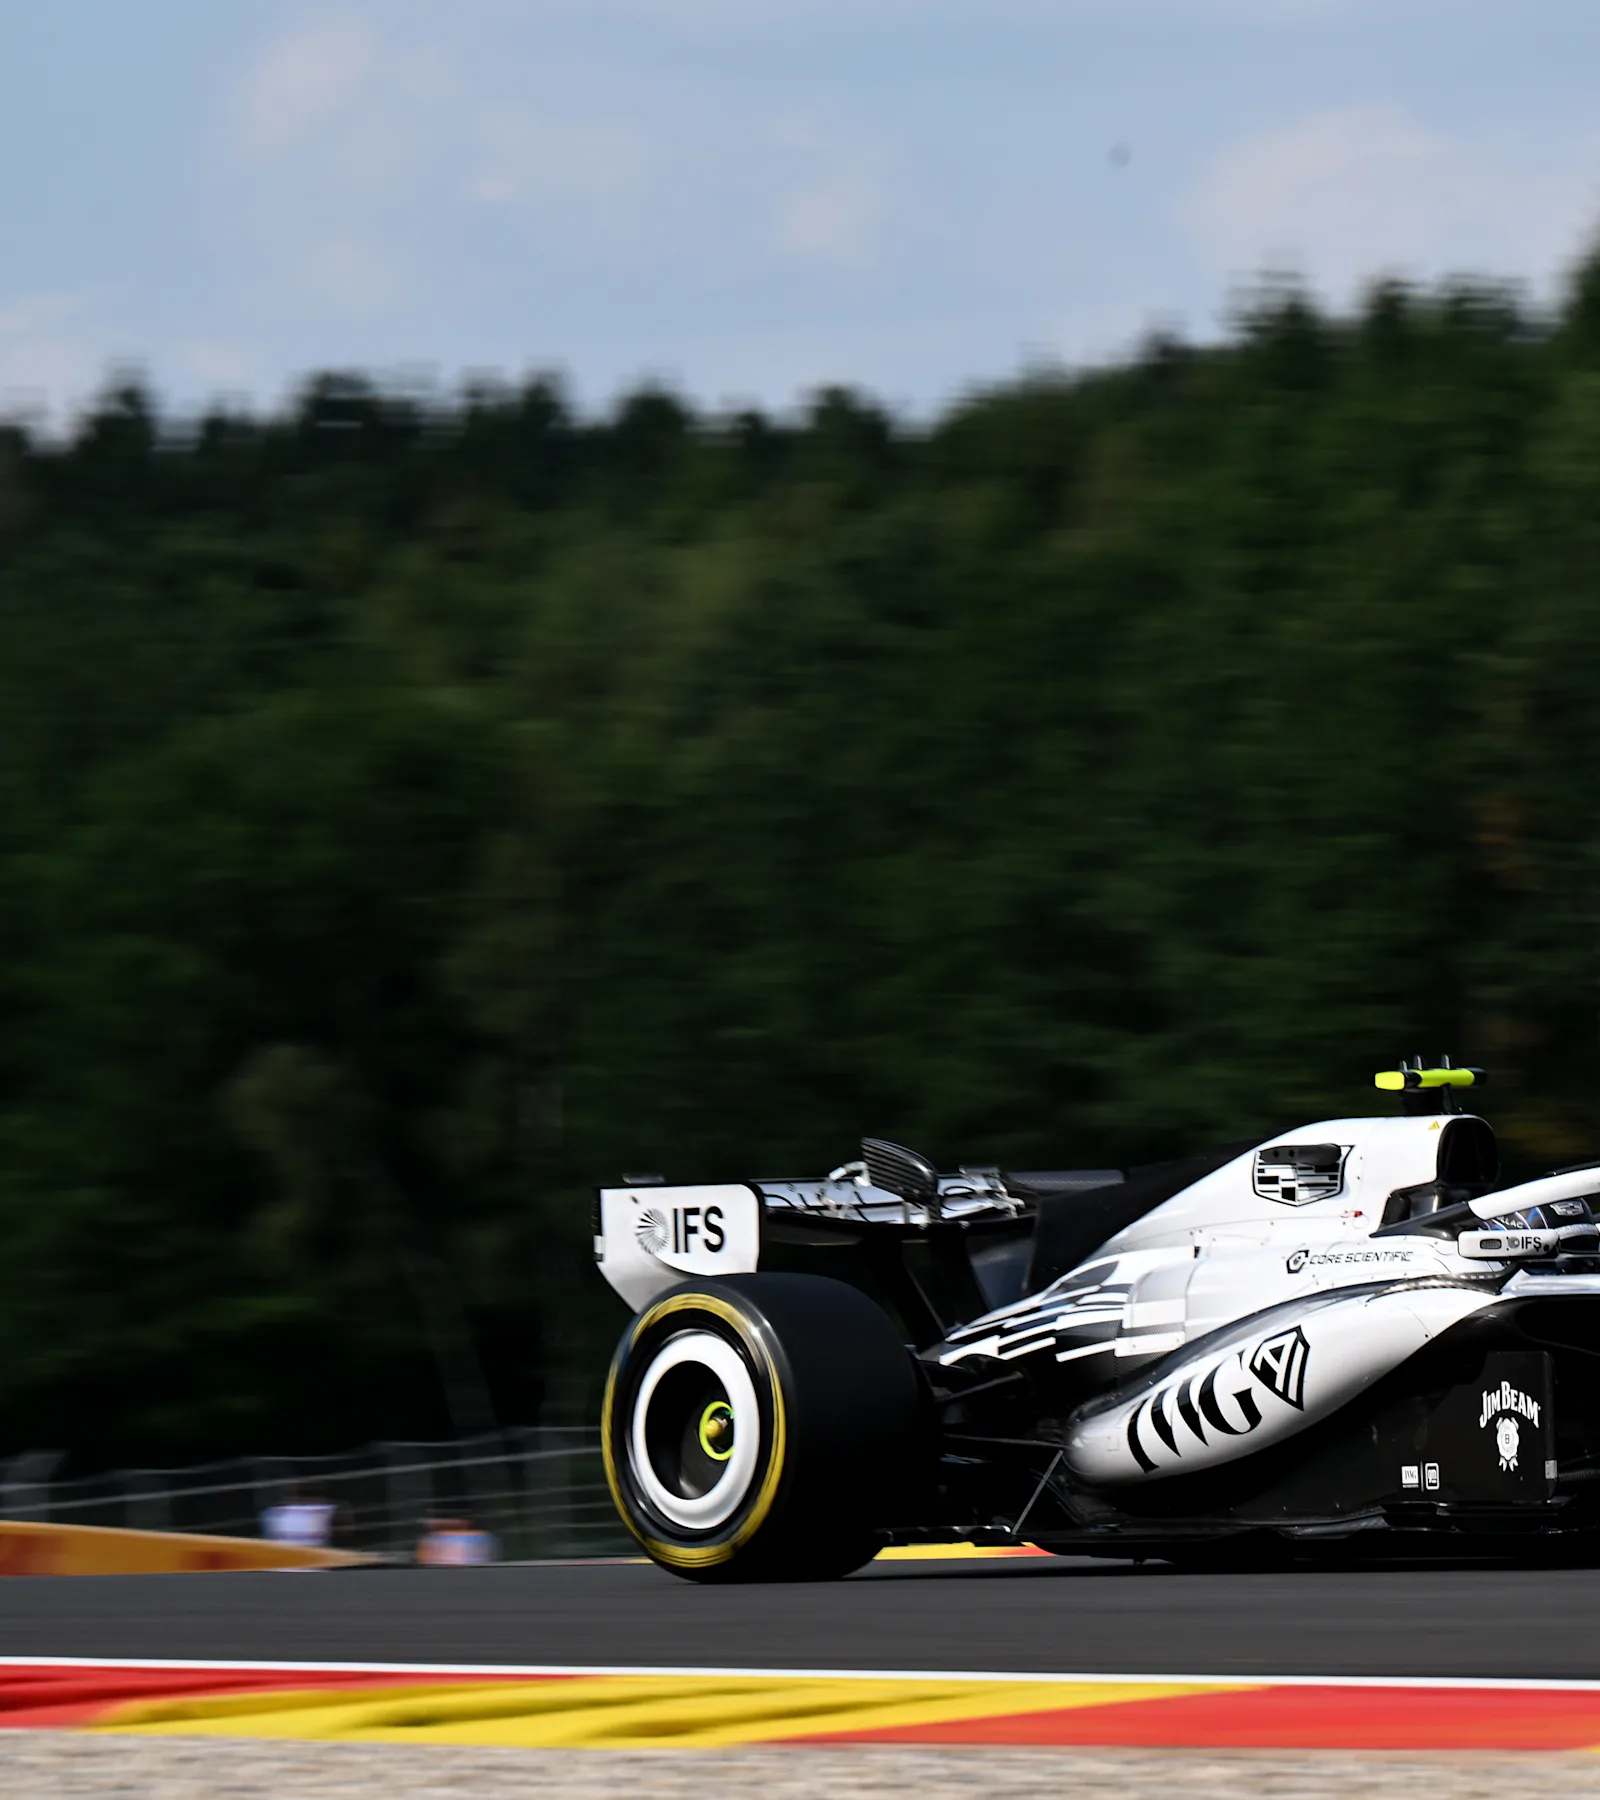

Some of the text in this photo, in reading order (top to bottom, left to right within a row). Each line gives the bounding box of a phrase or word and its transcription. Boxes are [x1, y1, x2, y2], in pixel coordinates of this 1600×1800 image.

[673, 1206, 725, 1253] IFS
[1521, 1236, 1542, 1250] IFS
[1310, 1251, 1413, 1264] CORE SCIENTIFIC
[1479, 1381, 1539, 1428] JIM BEAM
